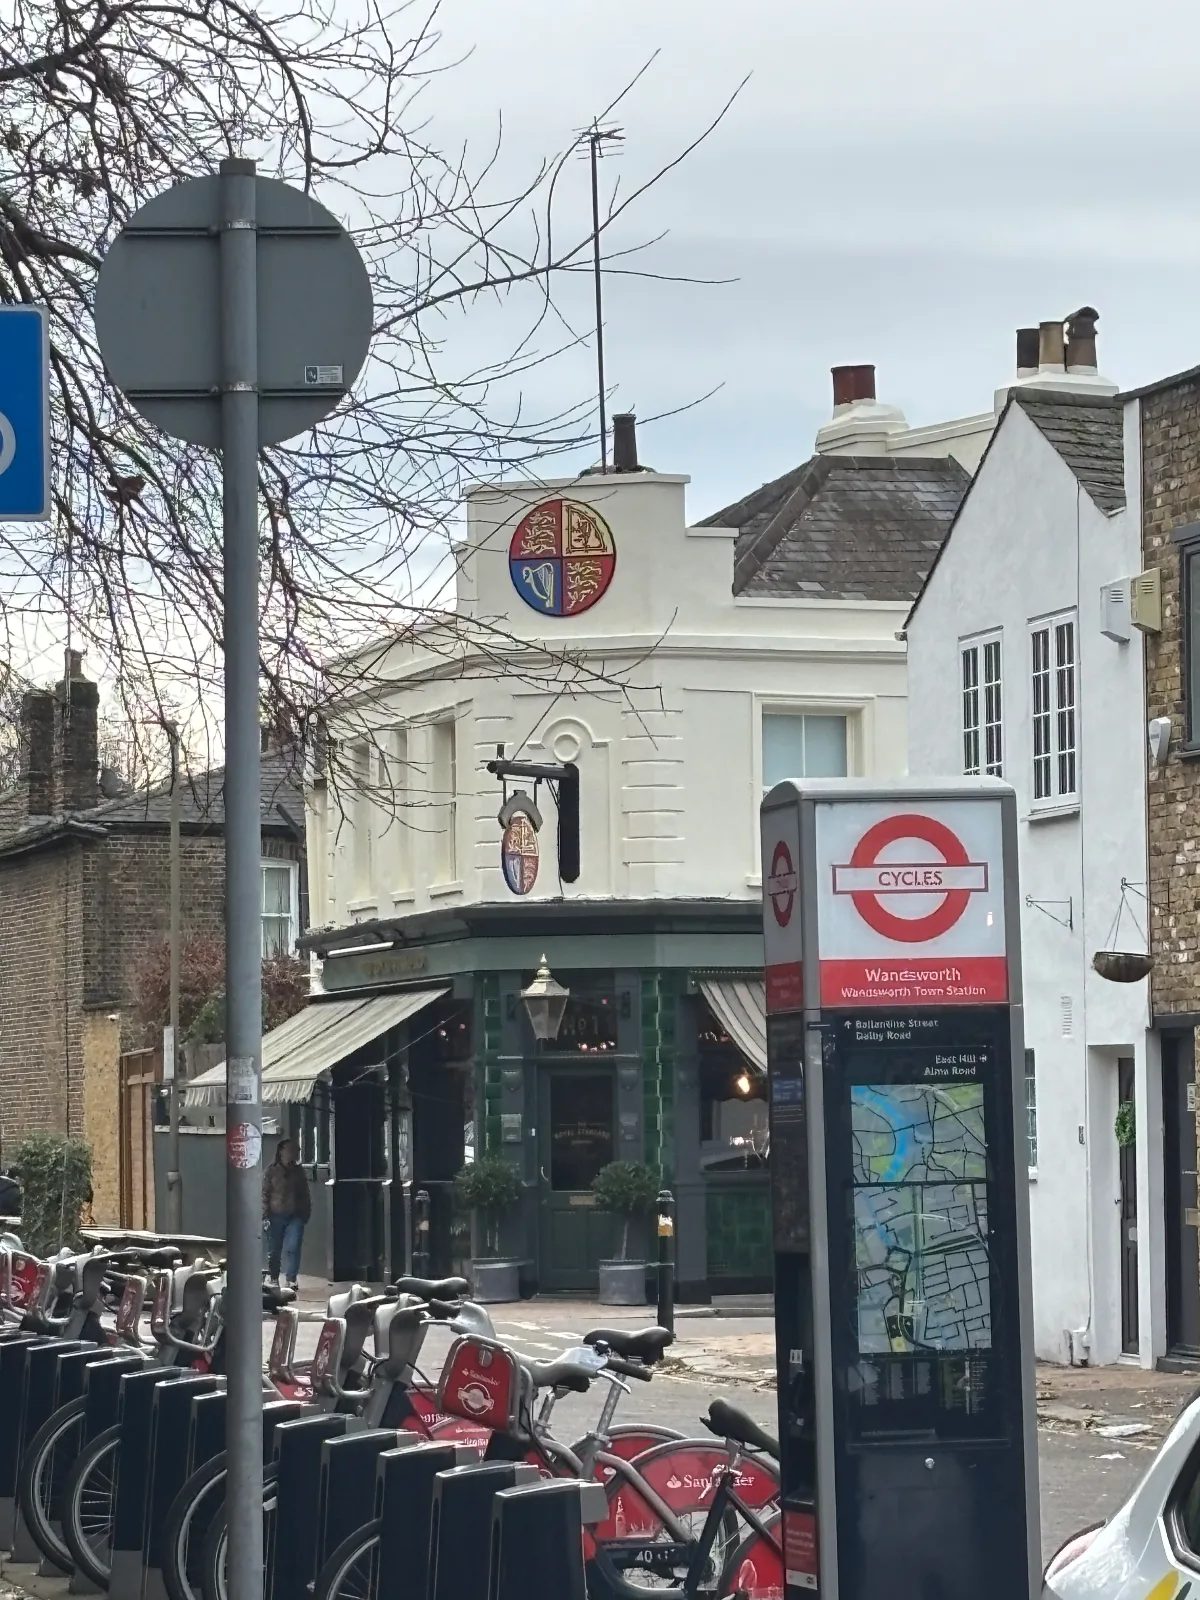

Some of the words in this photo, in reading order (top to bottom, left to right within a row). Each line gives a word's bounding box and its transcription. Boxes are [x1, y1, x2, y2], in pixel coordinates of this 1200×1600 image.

[878, 870, 943, 887] CYCLES
[864, 967, 961, 982] Wandsworth
[841, 986, 911, 998] Wandsworth
[913, 986, 944, 997] Town
[946, 985, 987, 996] Station
[887, 1031, 911, 1040] Road
[952, 1066, 976, 1076] Road
